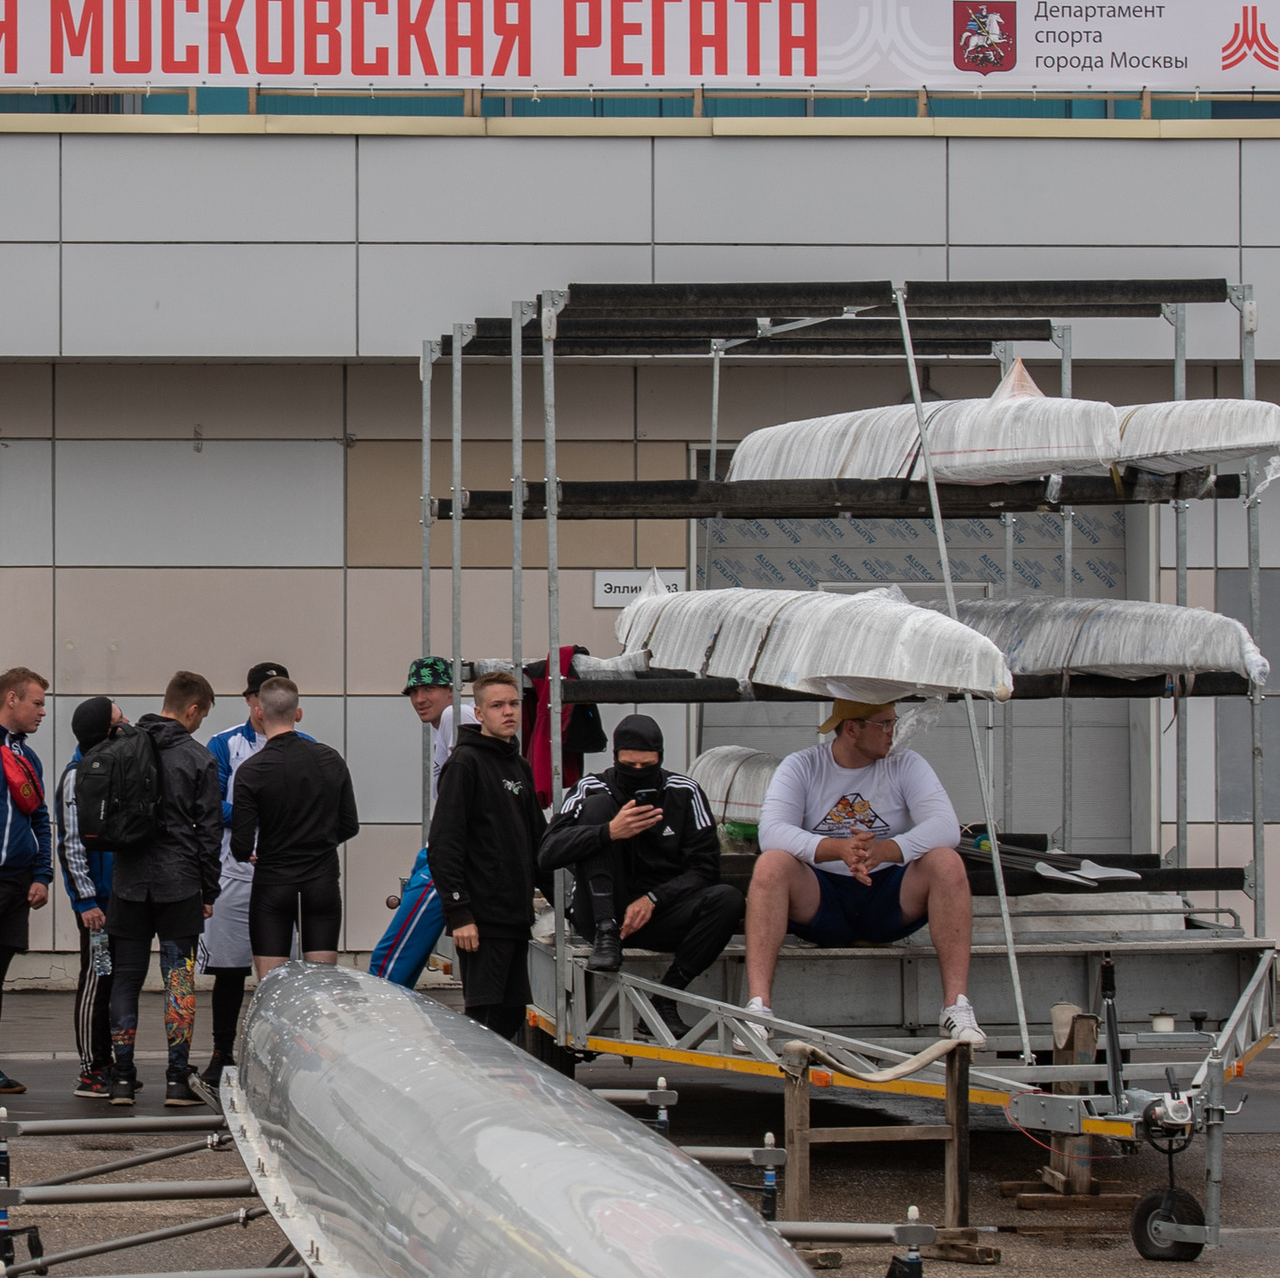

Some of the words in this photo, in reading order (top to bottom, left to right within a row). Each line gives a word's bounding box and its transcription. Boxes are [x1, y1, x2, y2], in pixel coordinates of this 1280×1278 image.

[1034, 1, 1166, 21] Департамент
[1035, 30, 1102, 47] спорта
[1036, 55, 1104, 72] города
[1111, 52, 1188, 69] Москвы
[774, 519, 800, 544] ALUTEC
[757, 554, 785, 582] ALUTECH
[787, 560, 817, 588] ALUTECH
[980, 554, 1005, 580] ALUTEC
[1086, 560, 1116, 589] ALUTECH
